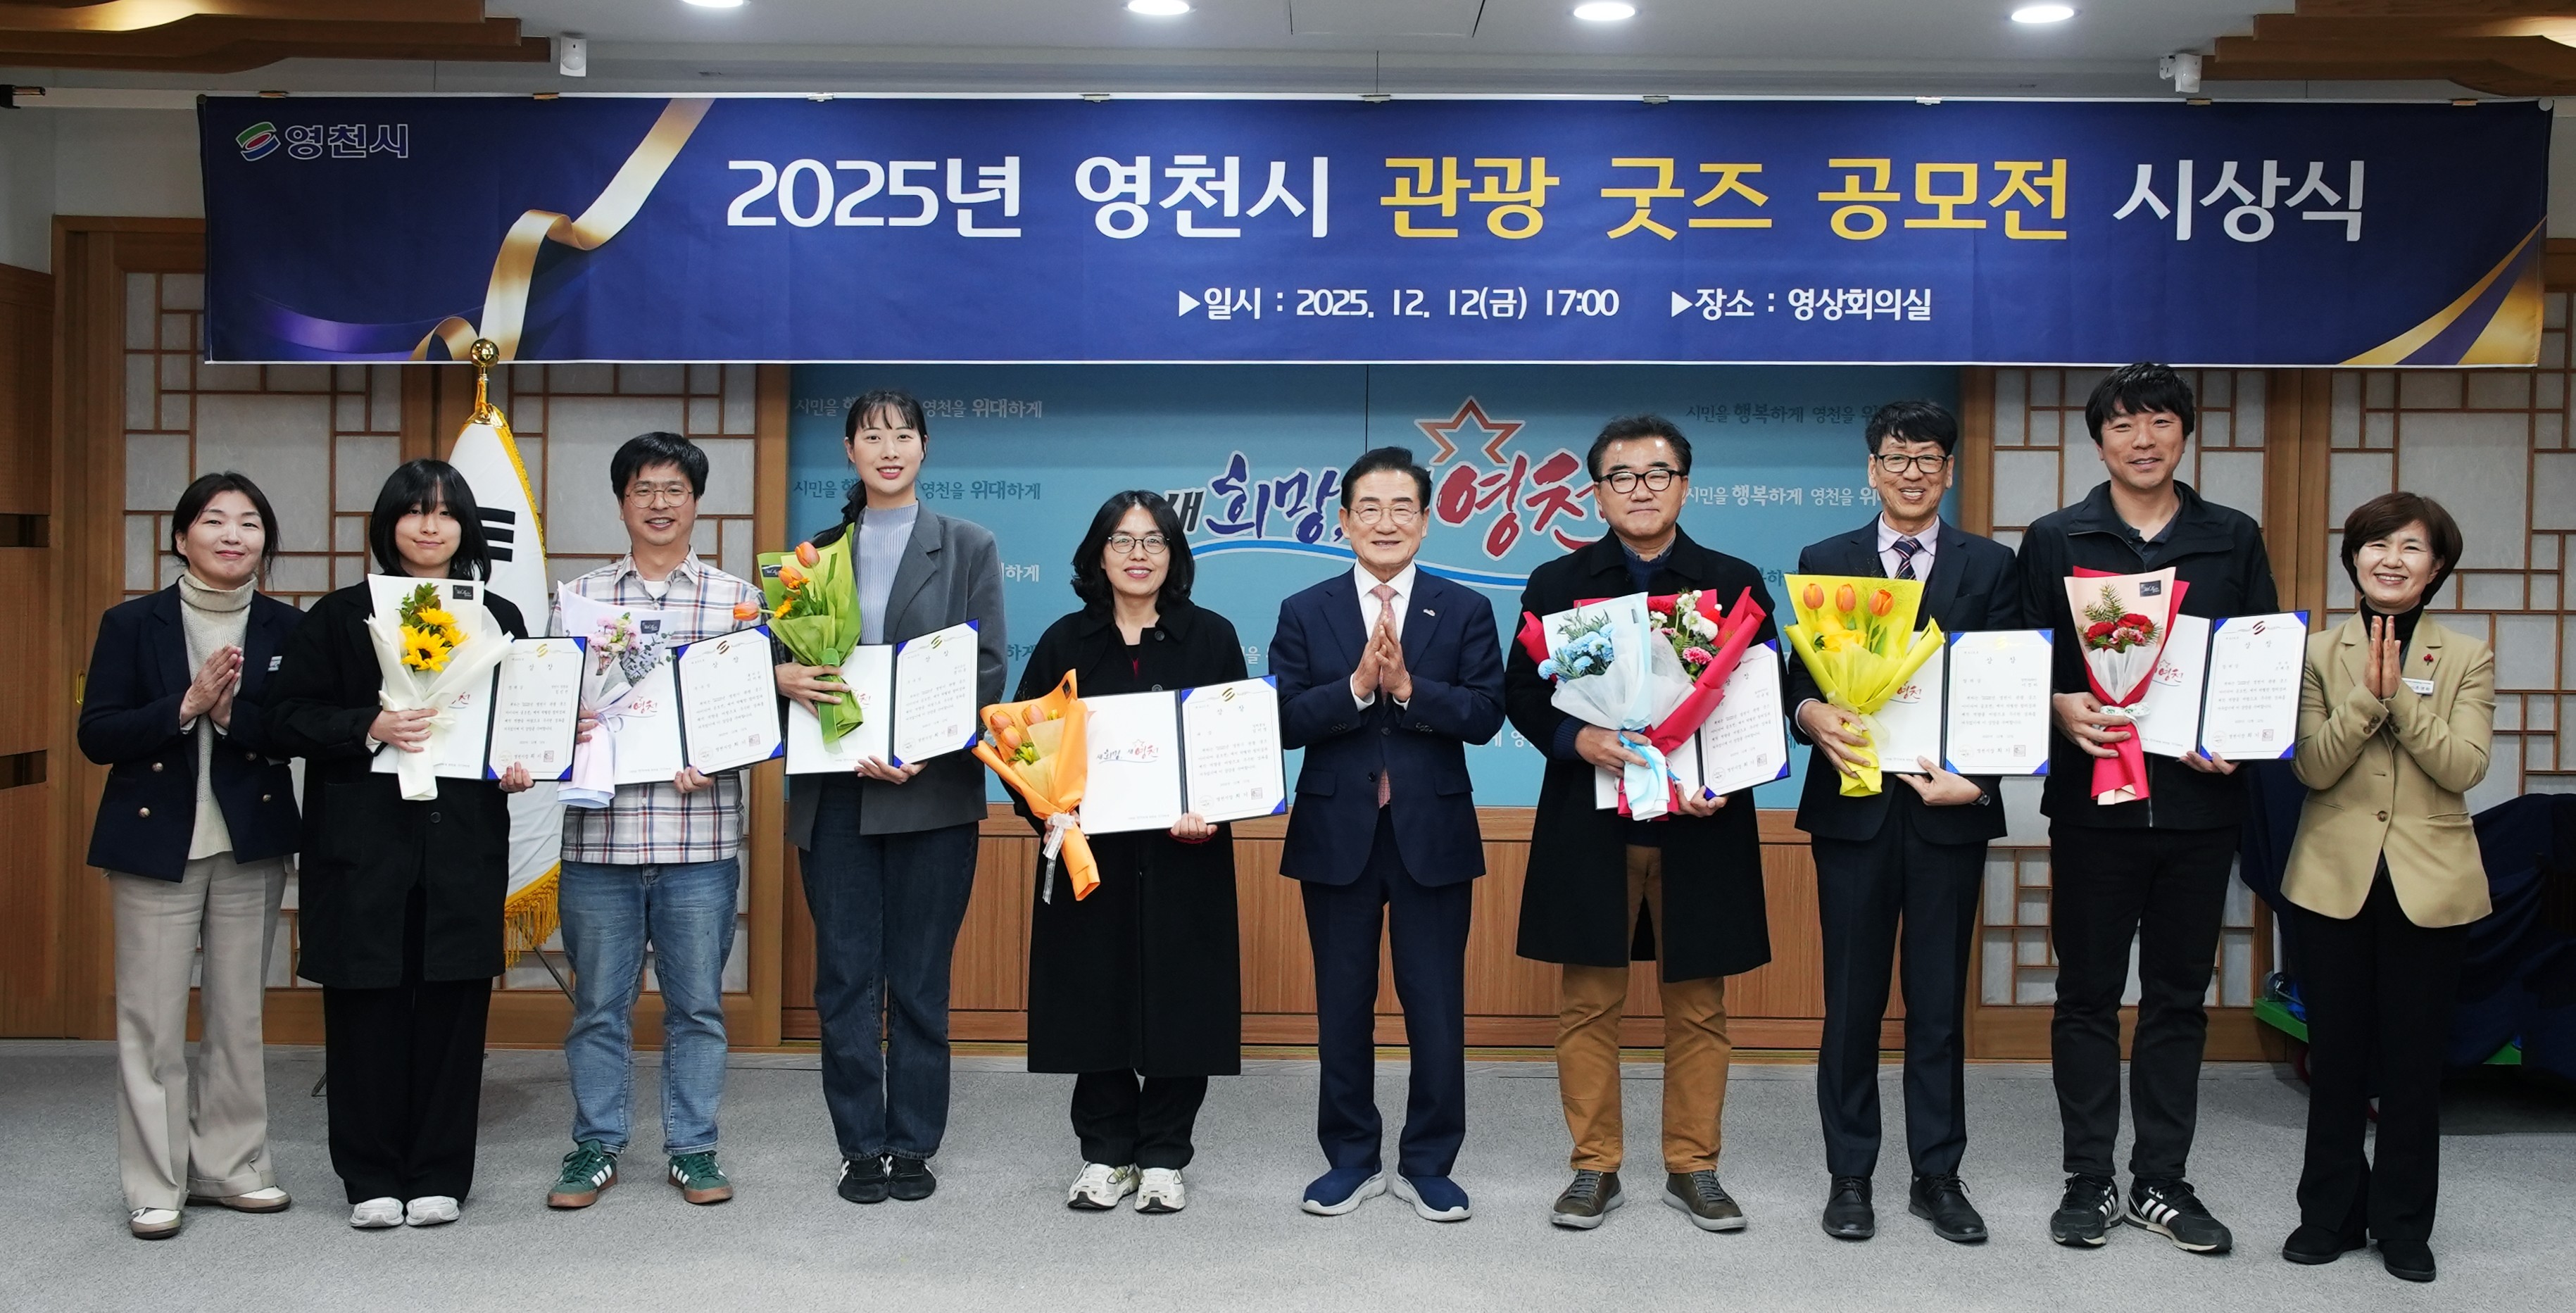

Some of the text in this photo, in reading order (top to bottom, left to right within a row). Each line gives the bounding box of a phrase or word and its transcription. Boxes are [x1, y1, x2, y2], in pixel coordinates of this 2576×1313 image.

[285, 124, 408, 160] 영천시
[726, 156, 2365, 242] 2025년 영천시 관광 굿즈 공모전 시상식
[1204, 287, 1261, 320] 일시
[1295, 289, 1374, 318] 2025.
[1393, 289, 1431, 318] 12.
[1449, 288, 1528, 320] 12(금)
[1546, 289, 1620, 317] 17:00
[1695, 288, 1755, 321] 장소
[1788, 288, 1932, 321] 영상회의실
[795, 399, 839, 417] 시민을
[922, 399, 967, 417] 영천을
[972, 398, 1043, 418] 위대하게
[1685, 405, 1729, 423] 시민을
[1733, 403, 1804, 424] 행복하게
[1812, 406, 1855, 424] 영천을
[793, 480, 838, 498] 시민을
[921, 480, 965, 499] 영천을
[970, 480, 1041, 501] 위대하게
[1687, 486, 1728, 505] 시민을
[1732, 484, 1803, 506] 행복하게
[1811, 486, 1854, 505] 영천을
[1000, 563, 1040, 582] 하게
[1897, 684, 1922, 699] 영천
[634, 700, 658, 714] 영천
[1135, 745, 1159, 760] 영천
